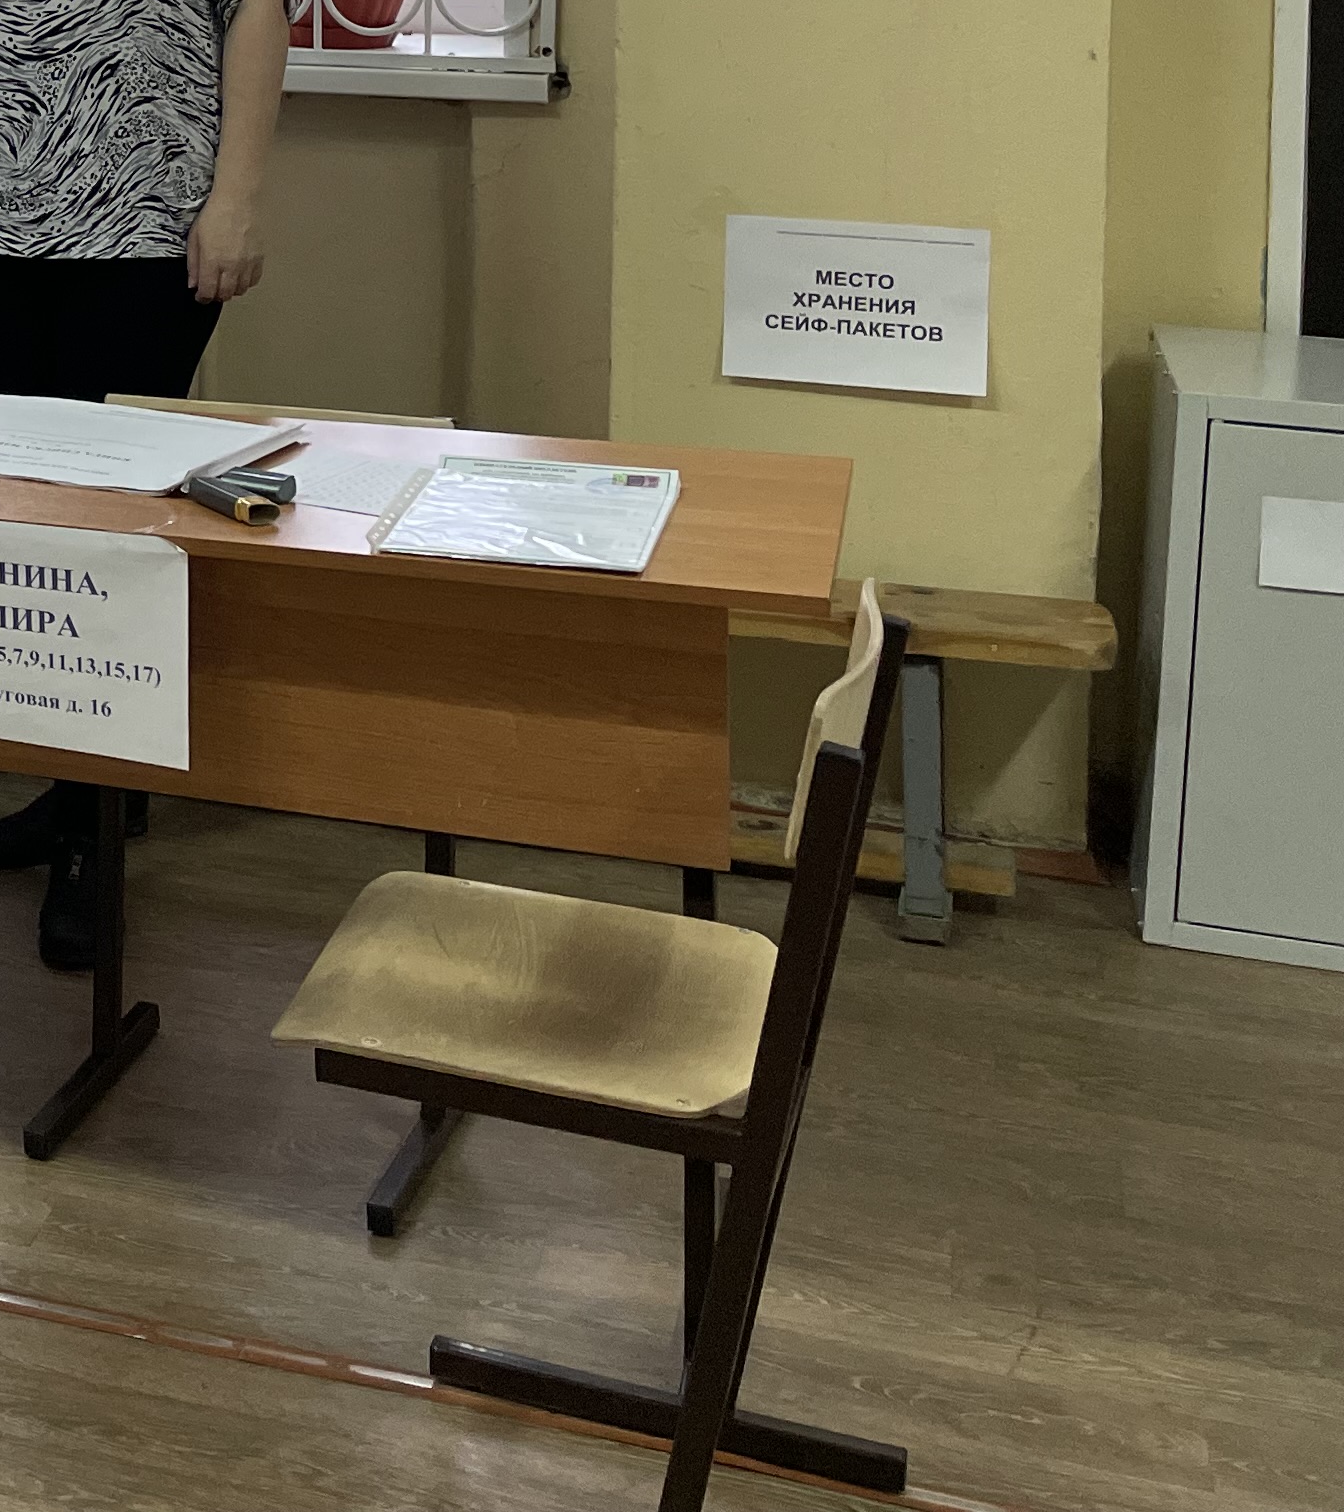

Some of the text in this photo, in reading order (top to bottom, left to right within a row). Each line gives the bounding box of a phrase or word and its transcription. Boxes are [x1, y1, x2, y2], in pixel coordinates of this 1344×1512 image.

[816, 270, 895, 290] МЕСТО
[792, 292, 916, 315] ХРАНЕНИЯ
[765, 313, 943, 342] СЕЙФ-ПАКЕТОВ
[66, 698, 83, 714] д.
[90, 699, 112, 718] 16
